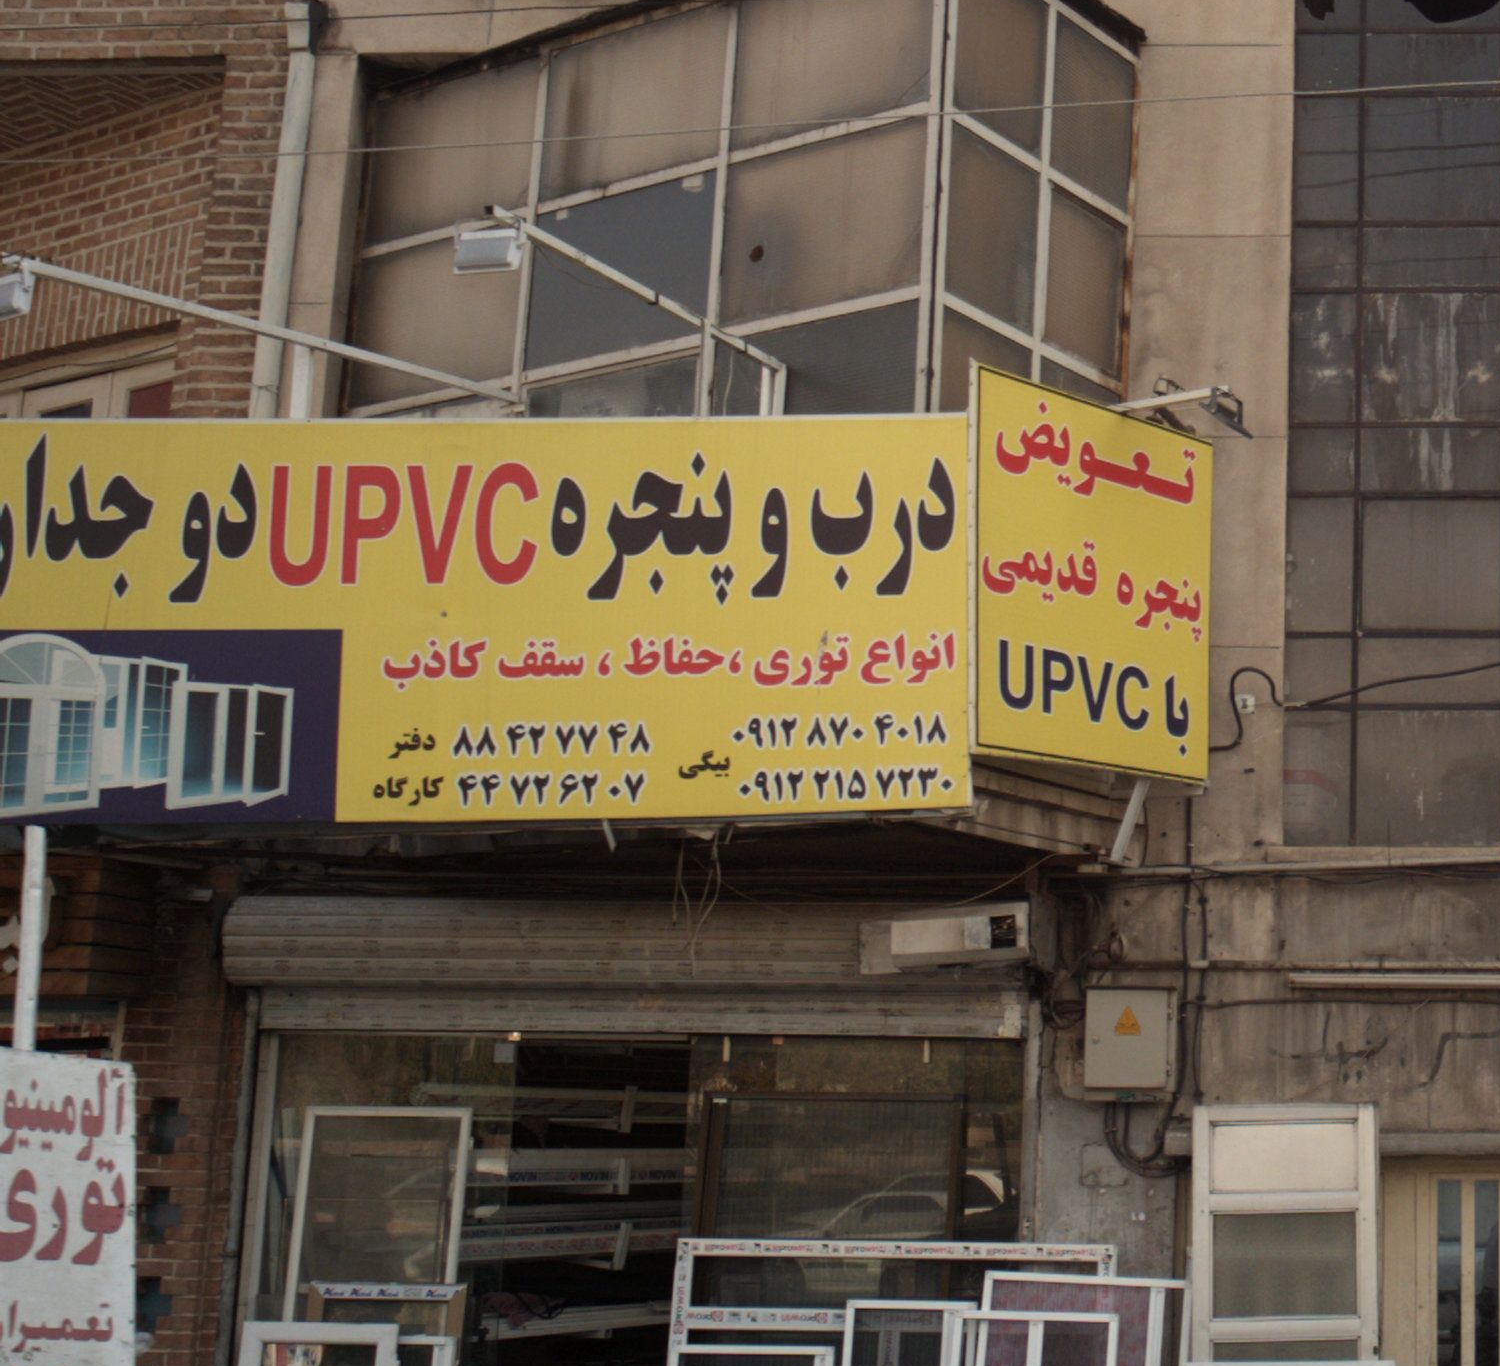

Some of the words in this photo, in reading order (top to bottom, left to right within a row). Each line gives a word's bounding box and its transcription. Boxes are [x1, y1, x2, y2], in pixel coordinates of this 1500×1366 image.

[996, 401, 1195, 505] تعویض
[168, 462, 257, 603] دو
[269, 462, 540, 586] UPVC
[550, 452, 733, 604] پنجره
[751, 487, 790, 598] و
[810, 457, 957, 597] درب
[982, 541, 1098, 603] قدیمی
[1117, 577, 1202, 641] پنجره
[382, 638, 486, 689] کاذب
[499, 639, 583, 677] سقف
[753, 635, 850, 686] توری
[860, 633, 956, 683] انواع
[999, 639, 1150, 731] UPVC
[388, 728, 437, 759] دفتر
[732, 717, 798, 748] ۰۹۱۲
[806, 716, 865, 747] ۸۷۰
[874, 713, 948, 745] ۴۰۱۸
[1164, 674, 1190, 756] با
[372, 775, 445, 806] کارگاه
[738, 772, 803, 805] ۰۹۱۲
[814, 769, 867, 801] ۲۱۵
[875, 767, 955, 799] ۷۲۳۰
[580, 1171, 609, 1181] NOVIN
[0, 1300, 114, 1352] تعمیرا
